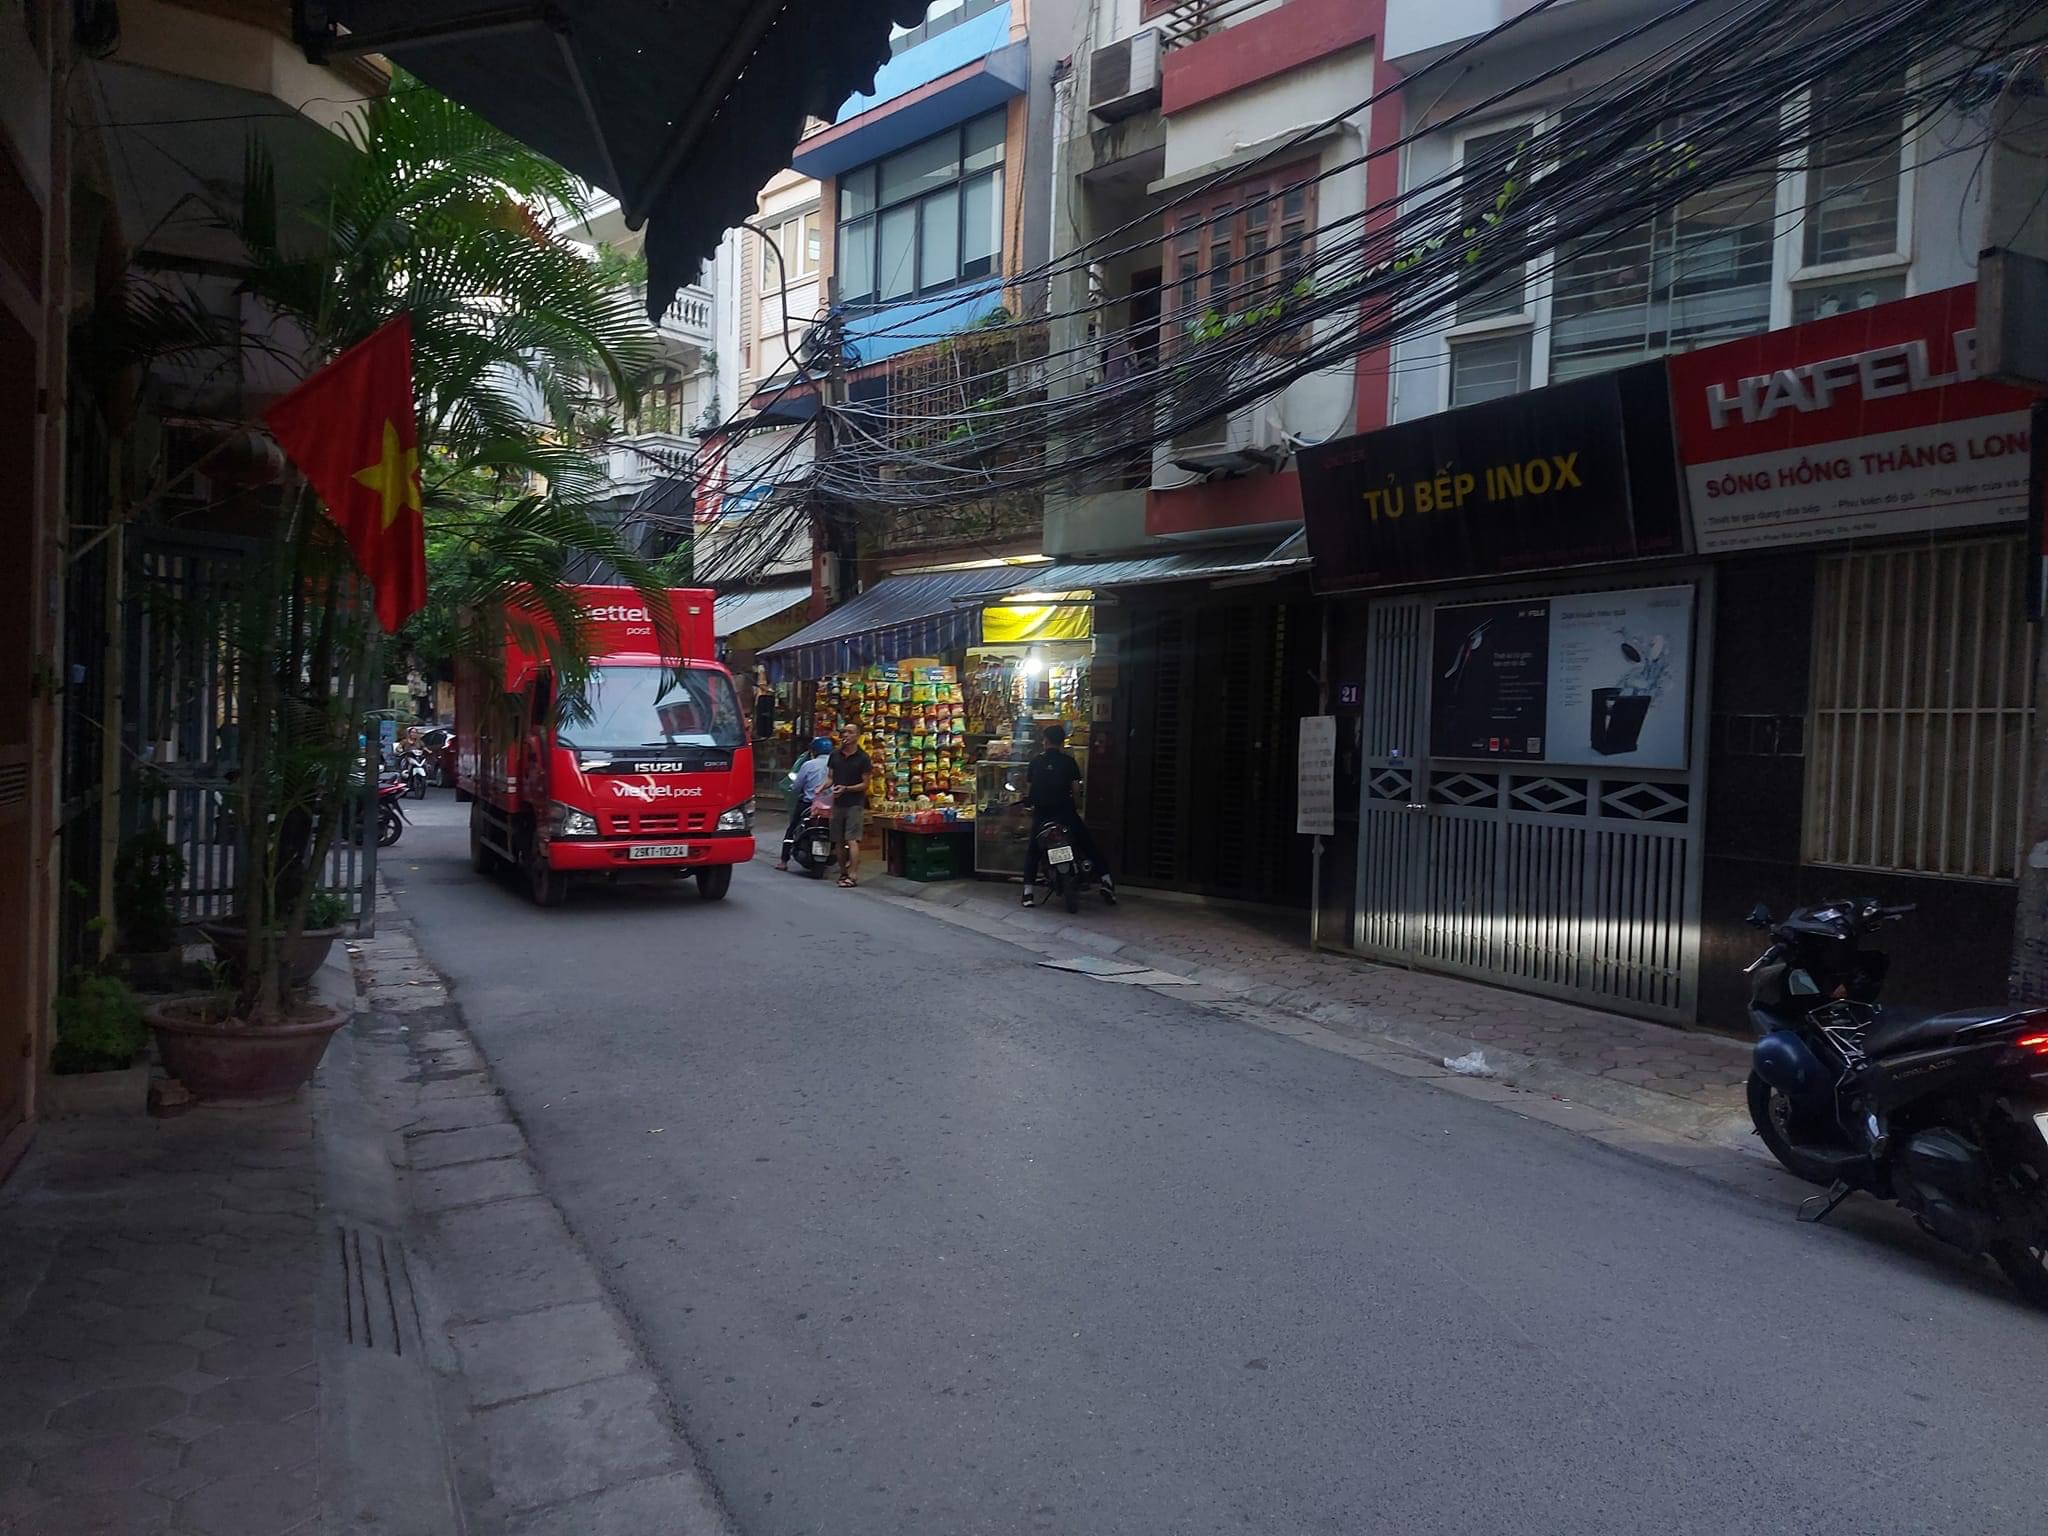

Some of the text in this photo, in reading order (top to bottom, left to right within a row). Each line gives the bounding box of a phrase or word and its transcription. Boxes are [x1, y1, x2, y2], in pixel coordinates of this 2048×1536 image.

[1860, 443, 1956, 474] THĂNG
[1968, 432, 2031, 460] LON
[1363, 472, 1405, 521] TỦ
[1415, 461, 1475, 513] BẾP
[1486, 452, 1582, 501] INOX
[573, 604, 653, 622] iettel
[626, 626, 651, 636] post
[1341, 685, 1359, 703] 21
[634, 762, 683, 773] ISUZU
[612, 785, 703, 798] viettel post
